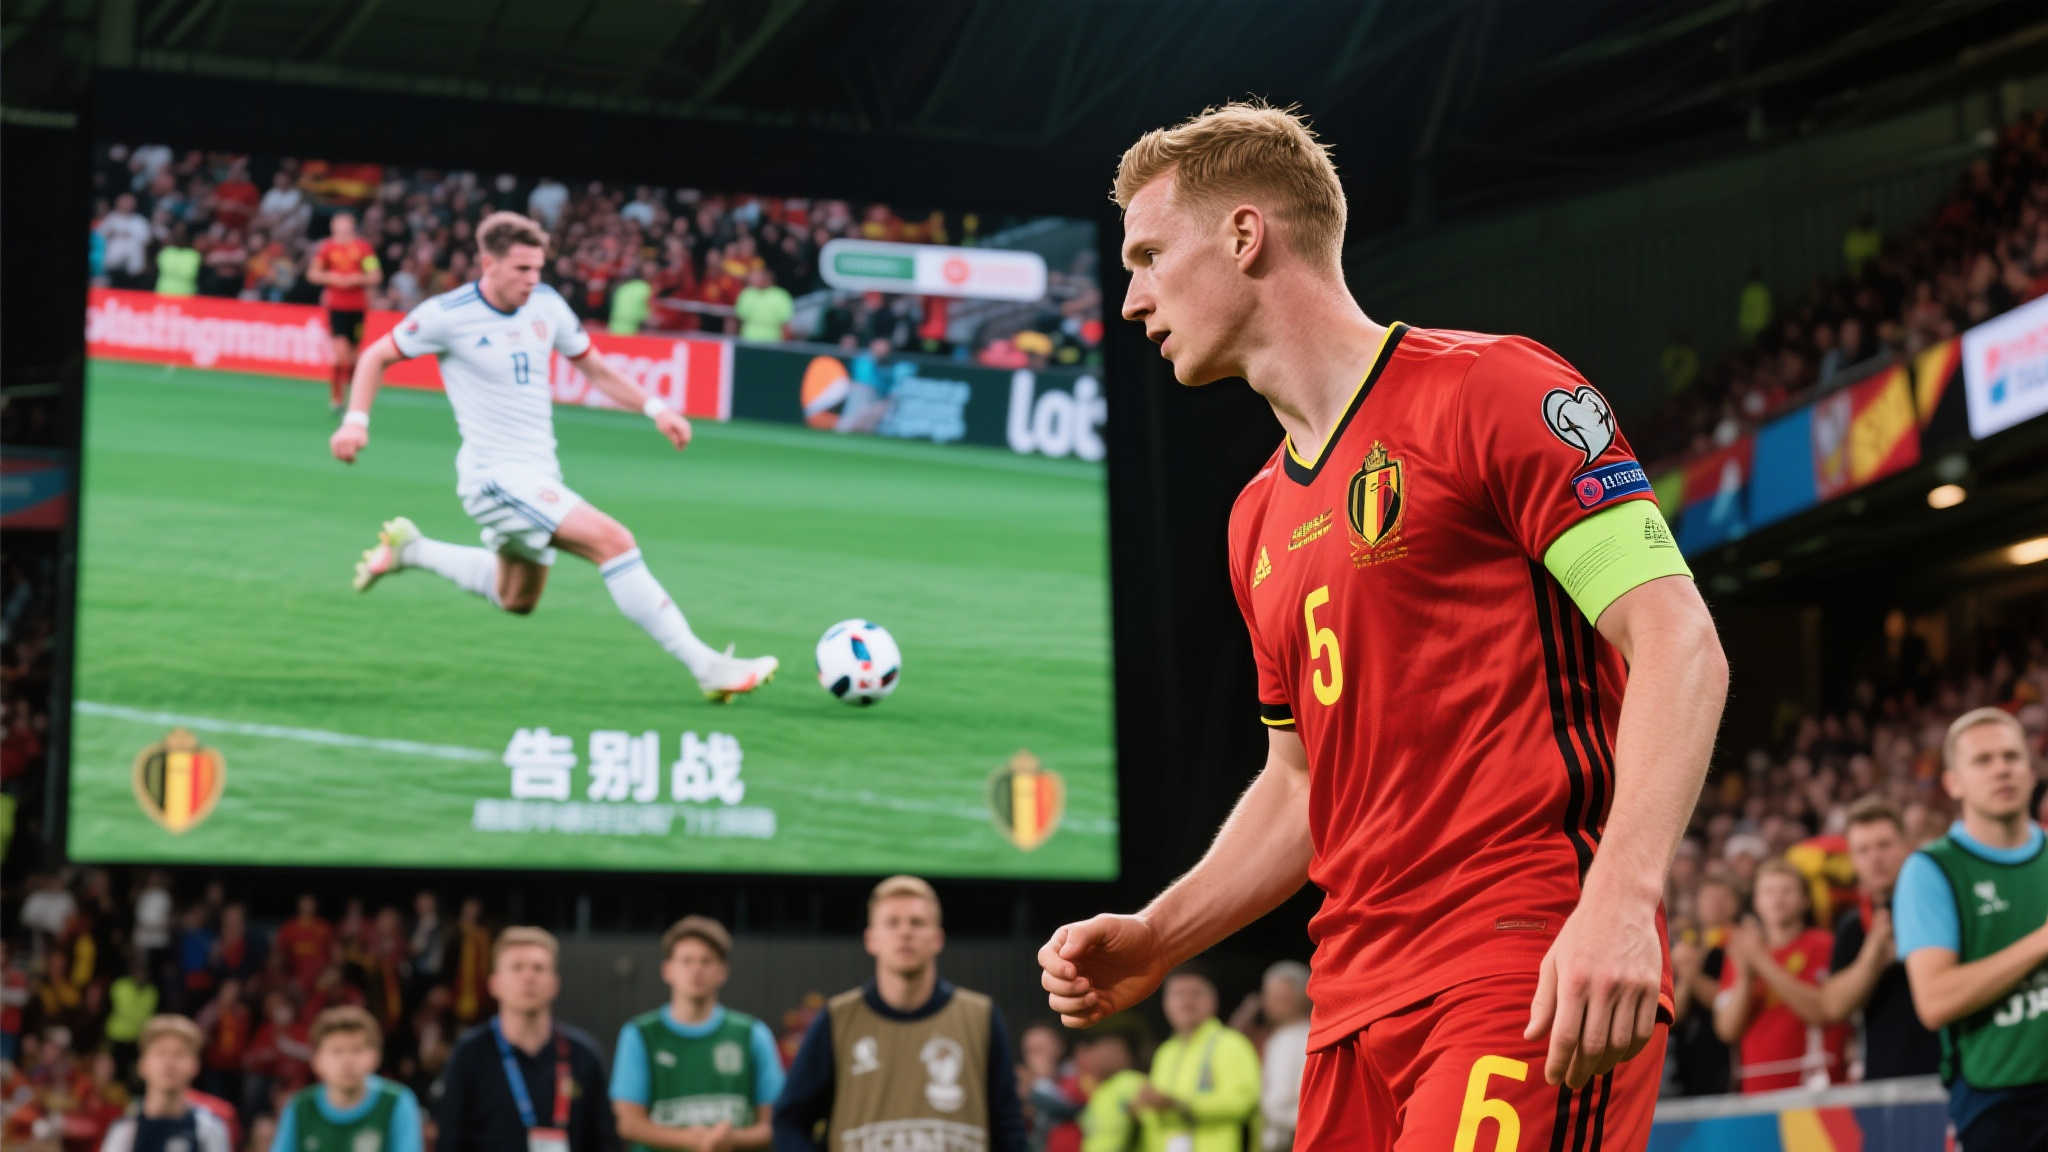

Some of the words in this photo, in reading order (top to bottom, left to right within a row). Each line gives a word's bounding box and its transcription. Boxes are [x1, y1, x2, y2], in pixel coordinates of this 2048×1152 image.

[1304, 585, 1344, 706] 5
[503, 727, 745, 806] 告别战
[1453, 1054, 1529, 1152] 6
